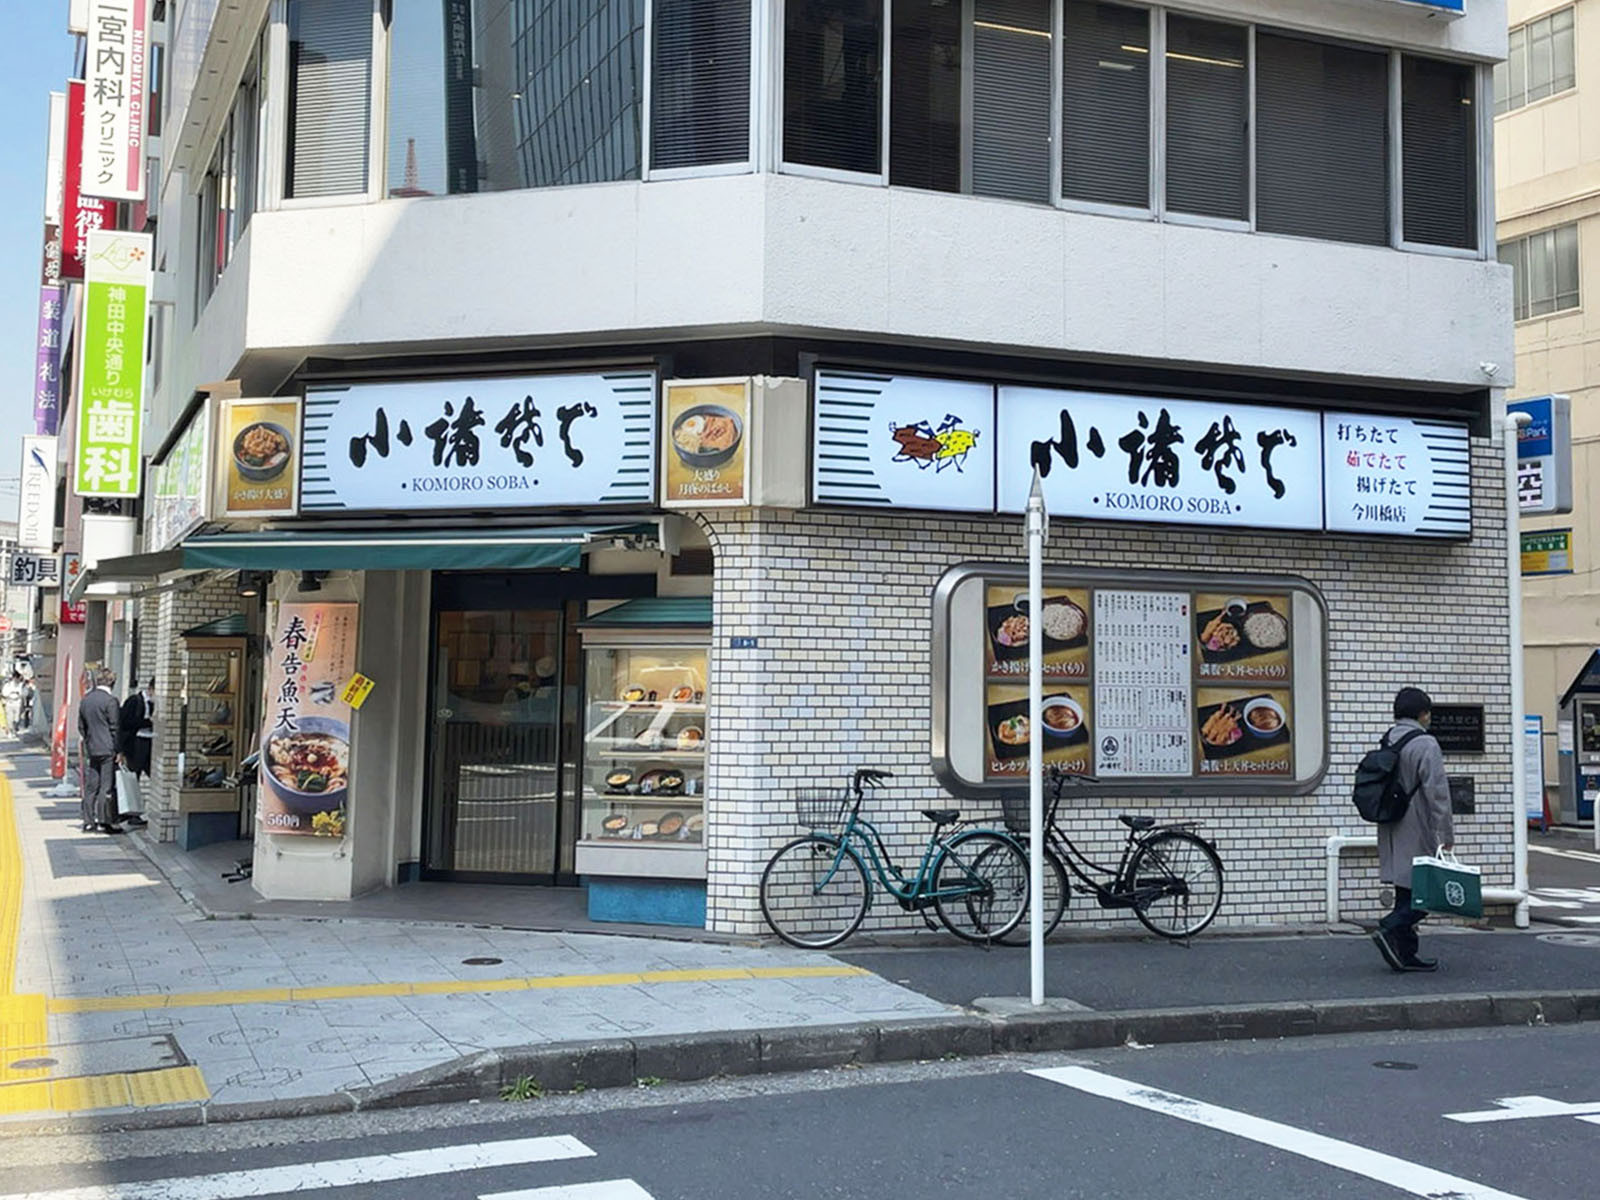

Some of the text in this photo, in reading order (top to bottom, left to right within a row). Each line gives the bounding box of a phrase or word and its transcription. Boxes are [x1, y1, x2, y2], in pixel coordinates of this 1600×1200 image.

[128, 29, 144, 148] NINOMIYA CLINIC
[105, 286, 127, 386] 神田中央通り
[1337, 423, 1399, 444] 打ちたて
[83, 399, 135, 492] 歯科
[1346, 450, 1407, 470] 茹でたて
[411, 474, 530, 492] KOMORO SOBA
[1357, 475, 1417, 496] 揚げたて
[1105, 492, 1232, 515] KOMORO SOBA
[1352, 503, 1406, 523] 今川橋店
[14, 557, 58, 582] 釣具
[275, 616, 308, 731] 春告魚天
[991, 660, 1085, 673] かき揚げセット(もり)
[267, 813, 300, 828] 560円
